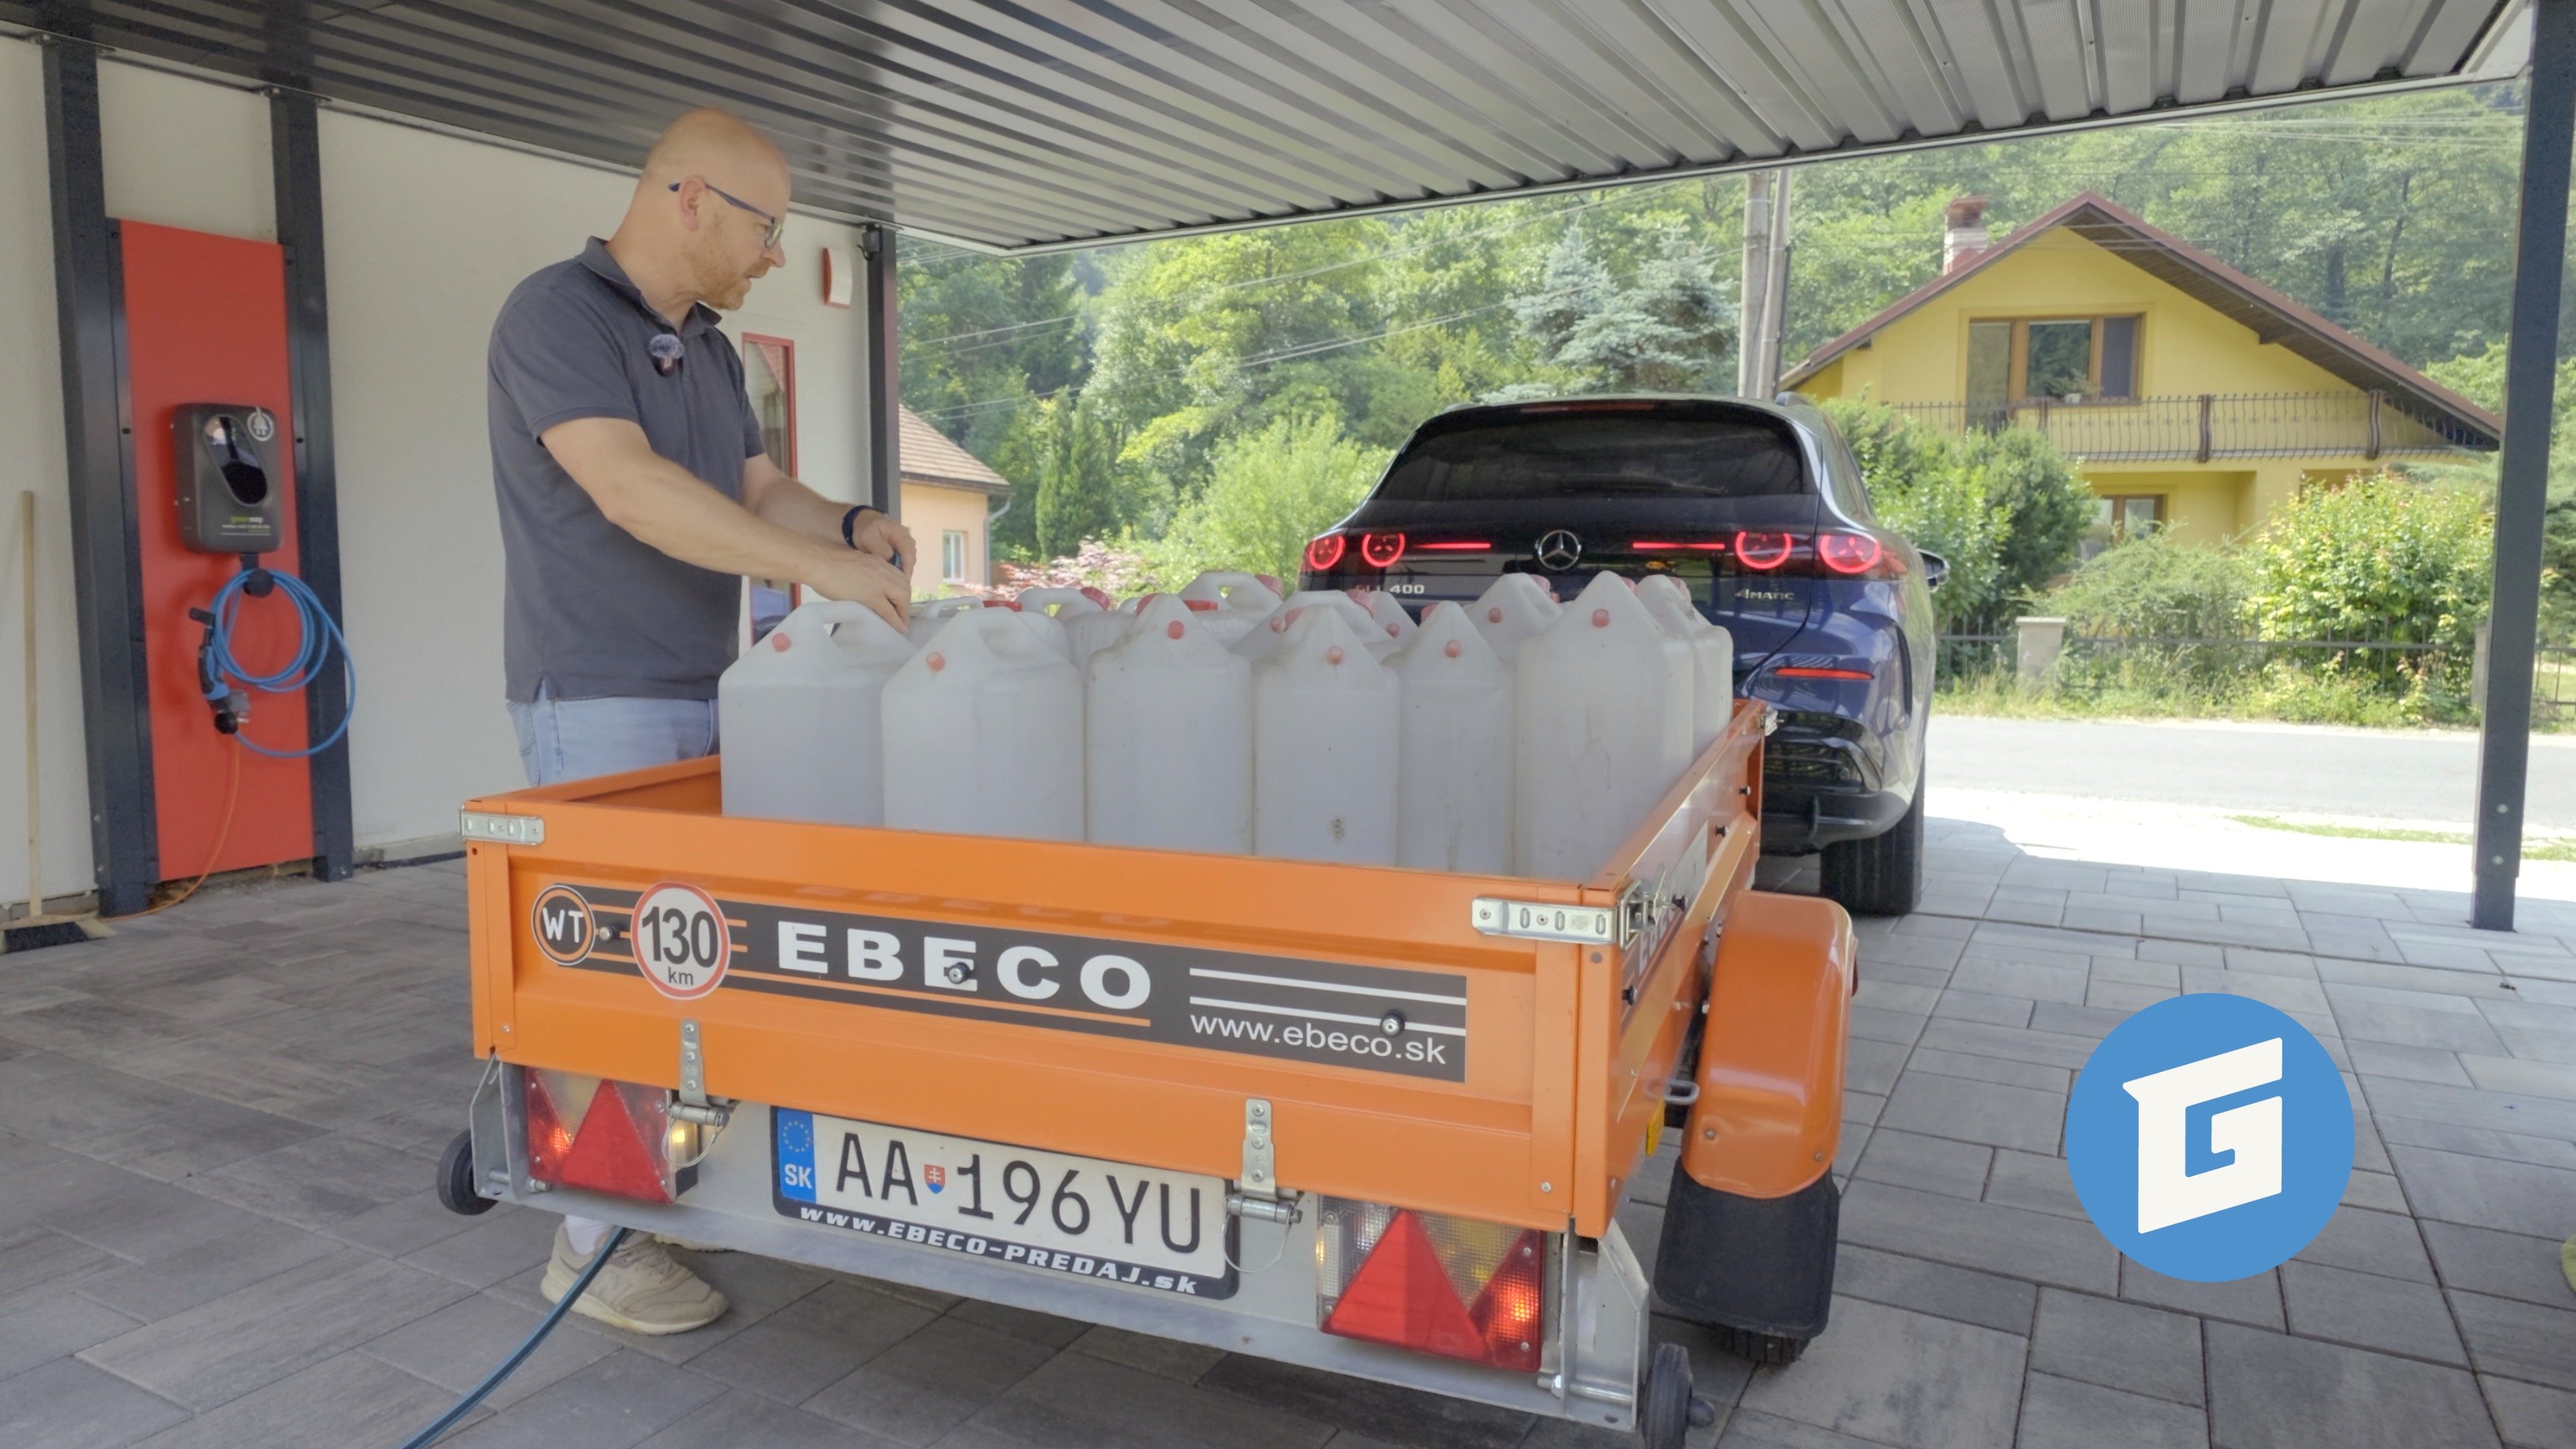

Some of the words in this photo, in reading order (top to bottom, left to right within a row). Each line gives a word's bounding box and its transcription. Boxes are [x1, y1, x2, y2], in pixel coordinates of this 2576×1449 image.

[1390, 584, 1424, 594] 400
[541, 908, 584, 943] WT
[641, 906, 718, 969] 130
[667, 965, 694, 987] km
[778, 921, 1151, 1010] EBECO
[1190, 1013, 1446, 1065] www.ebeco.sk
[784, 1163, 812, 1189] SK
[835, 1132, 918, 1206] AA
[957, 1152, 1201, 1254] 196YU
[800, 1207, 1195, 1295] www.EBECO-PREDAJ.sk
